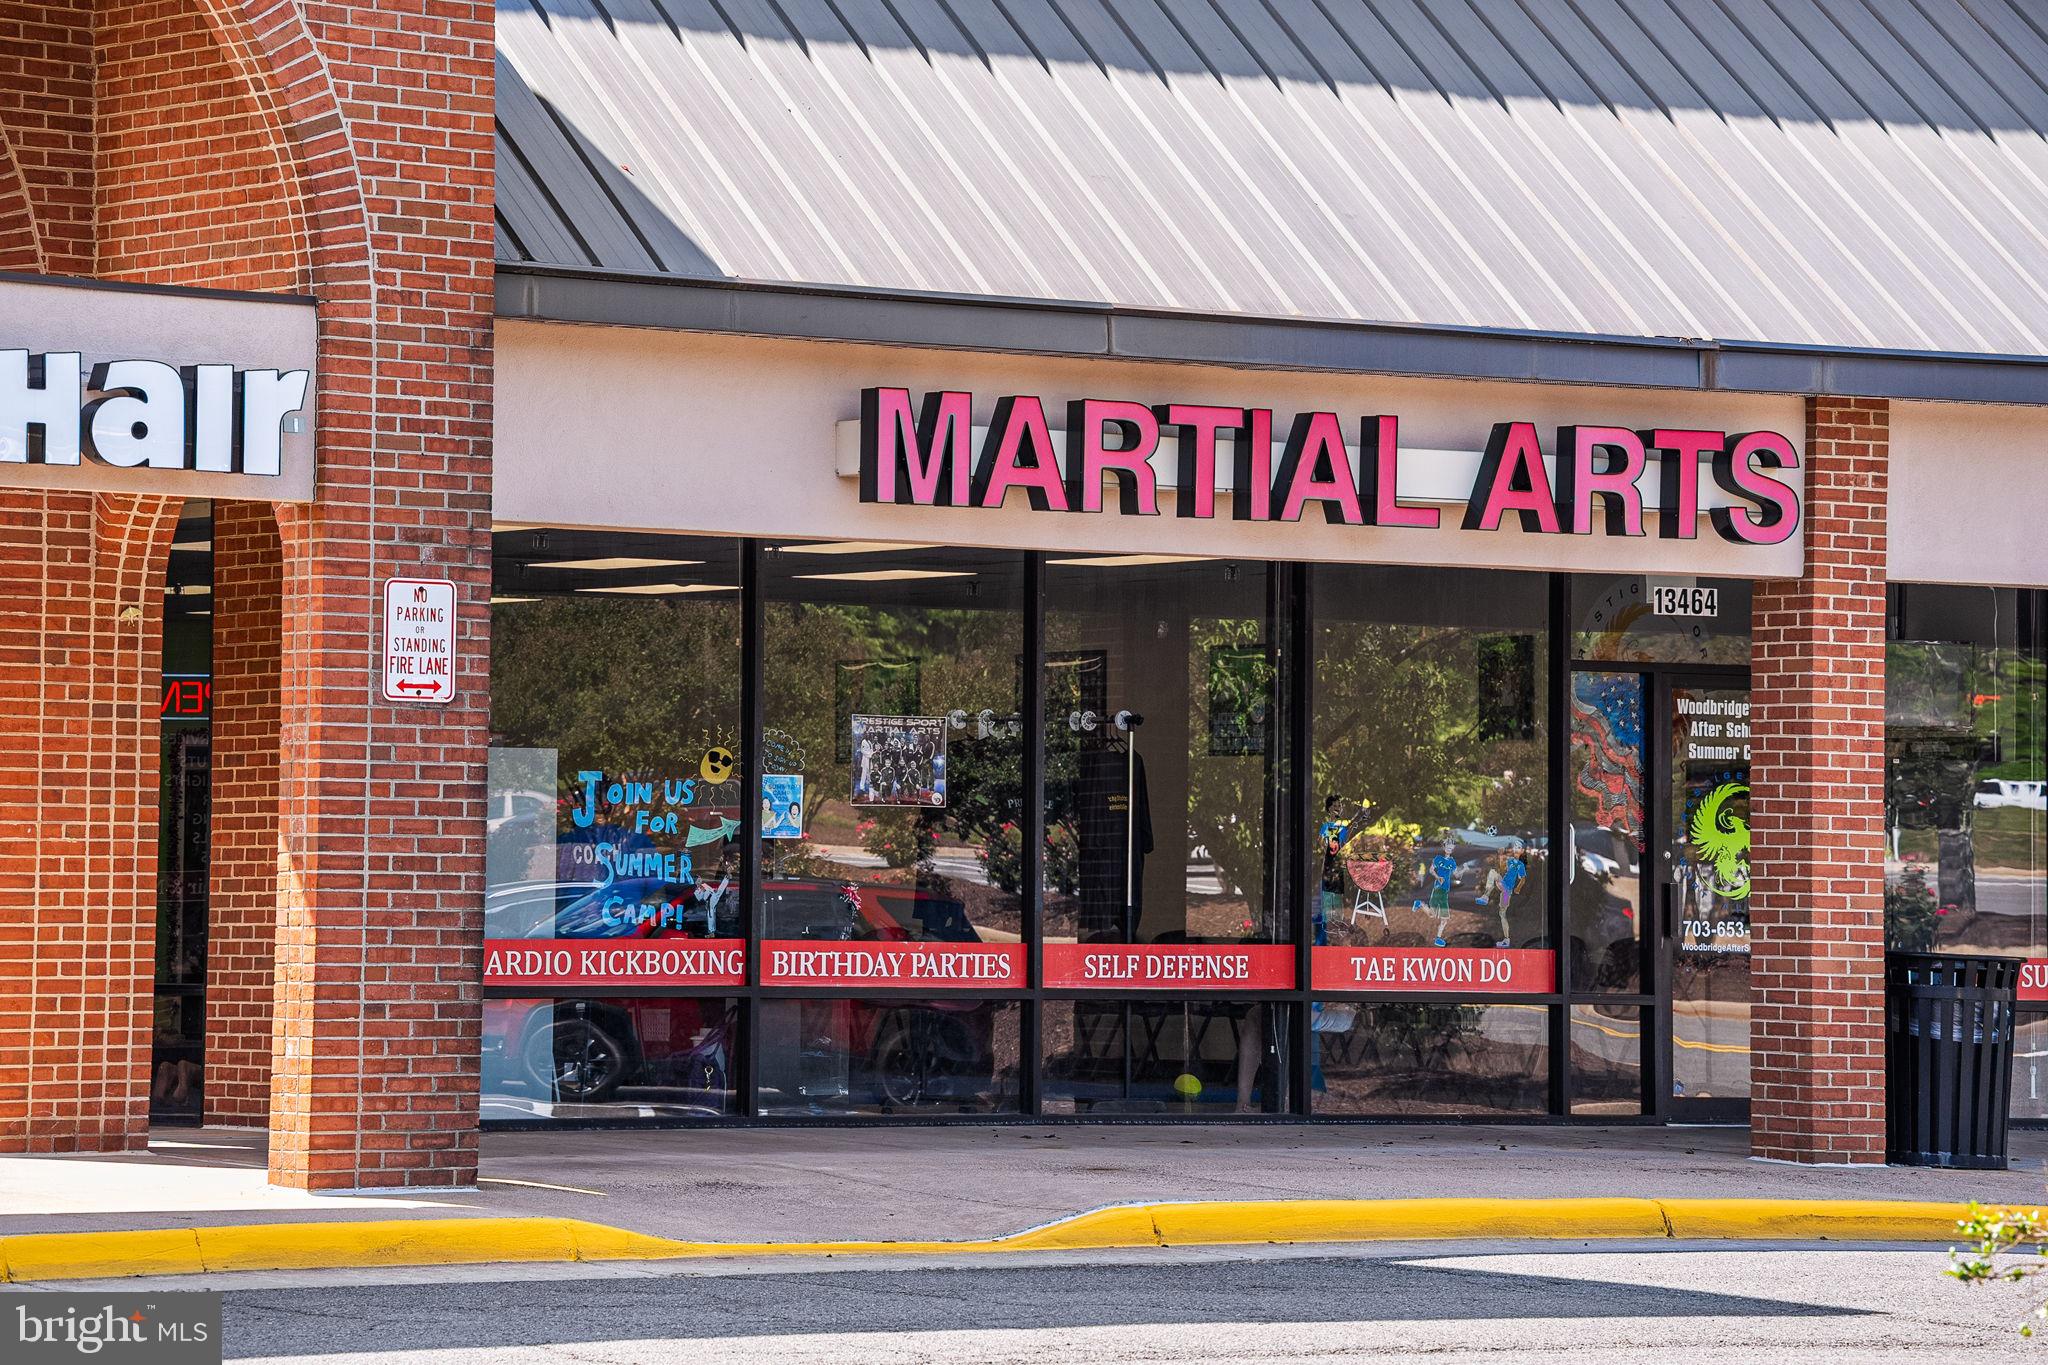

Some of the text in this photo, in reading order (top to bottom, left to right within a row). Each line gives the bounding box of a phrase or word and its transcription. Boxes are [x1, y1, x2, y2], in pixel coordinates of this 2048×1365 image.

[0, 348, 309, 476] Hair
[859, 386, 1800, 545] MARTIAL ARTS
[414, 587, 428, 603] NO
[1655, 588, 1717, 615] 13464
[397, 606, 444, 623] PARKING
[415, 625, 425, 634] OR
[393, 637, 446, 653] STANDING
[389, 656, 448, 676] FIRE LANE
[855, 717, 903, 726] PRESTIGE
[906, 719, 944, 727] SPORT
[857, 726, 940, 735] MARTIAL ARTS
[1690, 720, 1722, 738] After
[1688, 743, 1740, 760] Summer
[572, 770, 696, 828] JOIN US
[635, 810, 678, 835] FOR
[593, 842, 695, 890] SUMMER
[602, 896, 684, 931] CAMP!
[484, 950, 744, 976] ARDIO KICKBOXING
[771, 951, 1011, 979] BIRTHDAY PARTIES
[1084, 954, 1249, 979] SELF DEFENSE
[1350, 957, 1512, 983] TAE KWON DO
